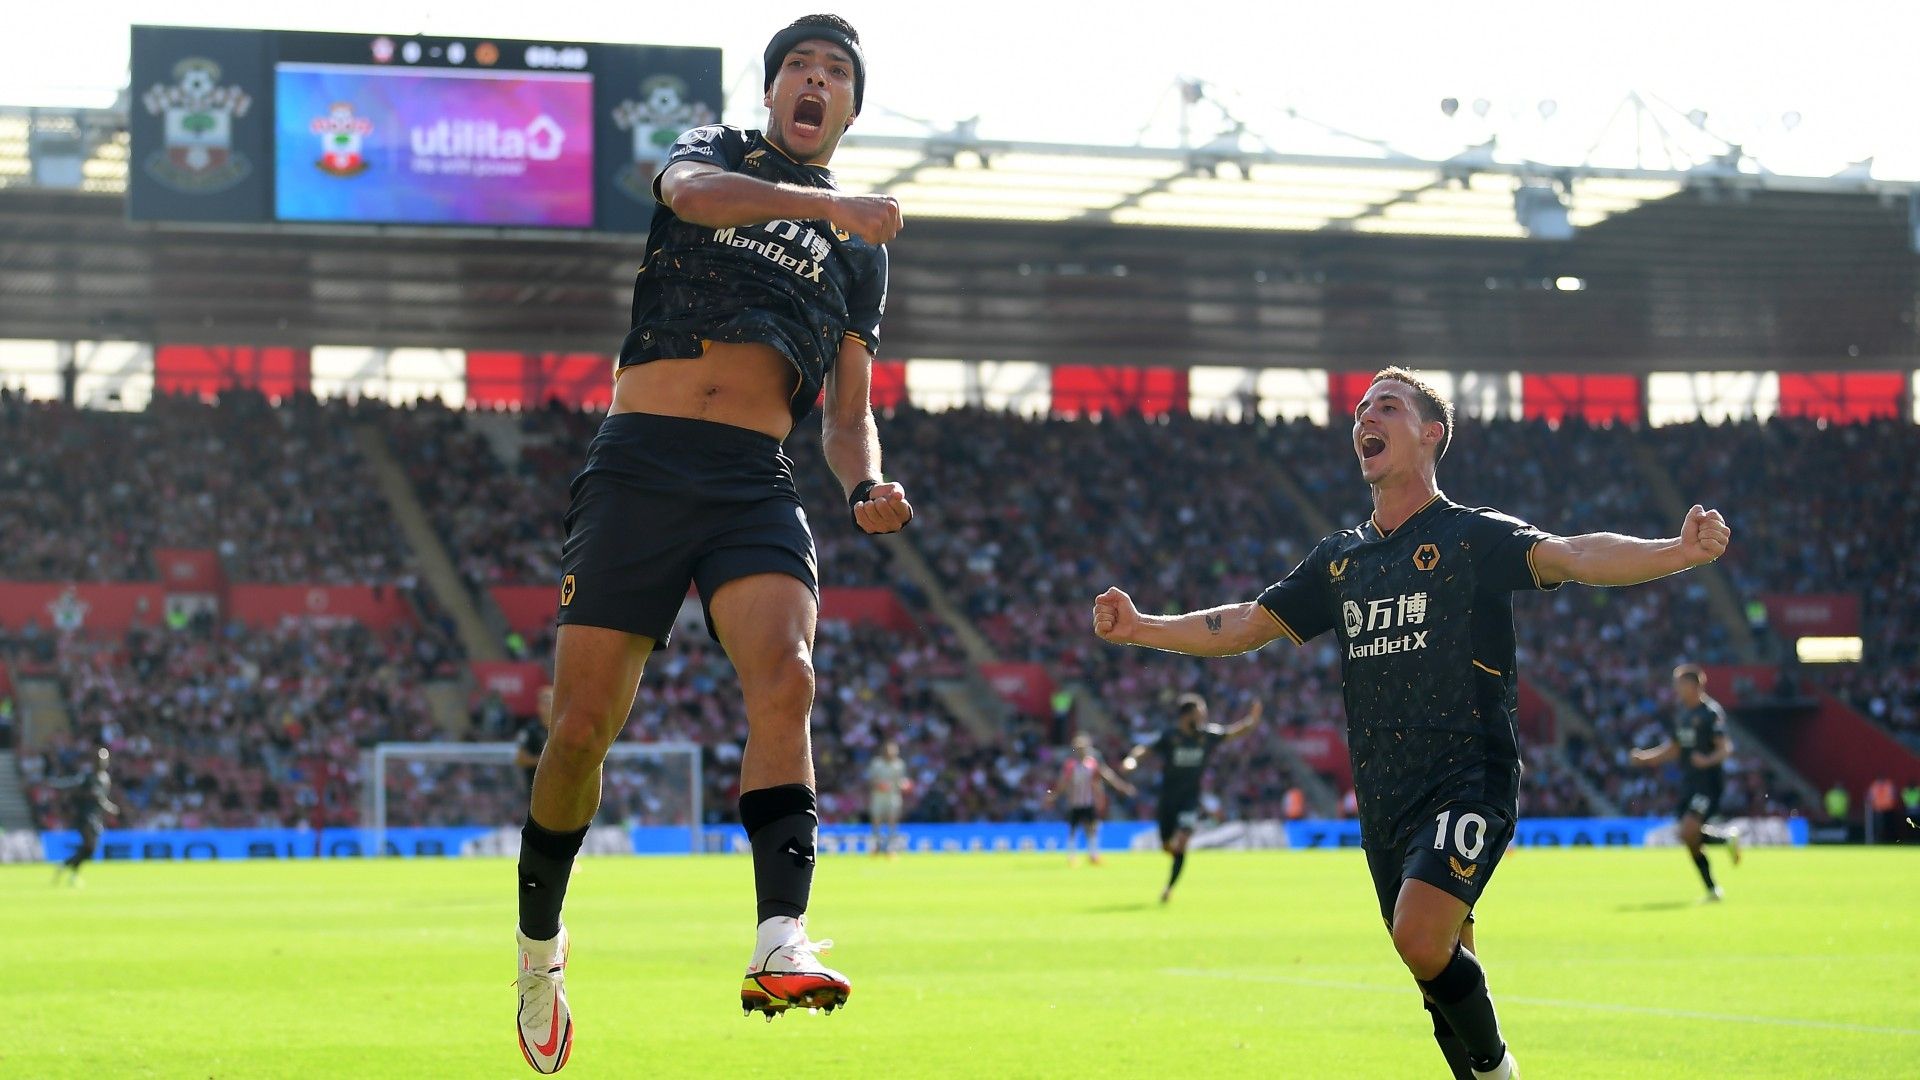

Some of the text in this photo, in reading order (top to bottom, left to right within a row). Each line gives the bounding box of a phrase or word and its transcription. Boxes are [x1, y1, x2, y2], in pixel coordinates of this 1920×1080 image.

[411, 119, 526, 158] utilita
[713, 227, 824, 283] ManBetX
[1366, 592, 1427, 632] 万博
[1433, 810, 1487, 860] 10
